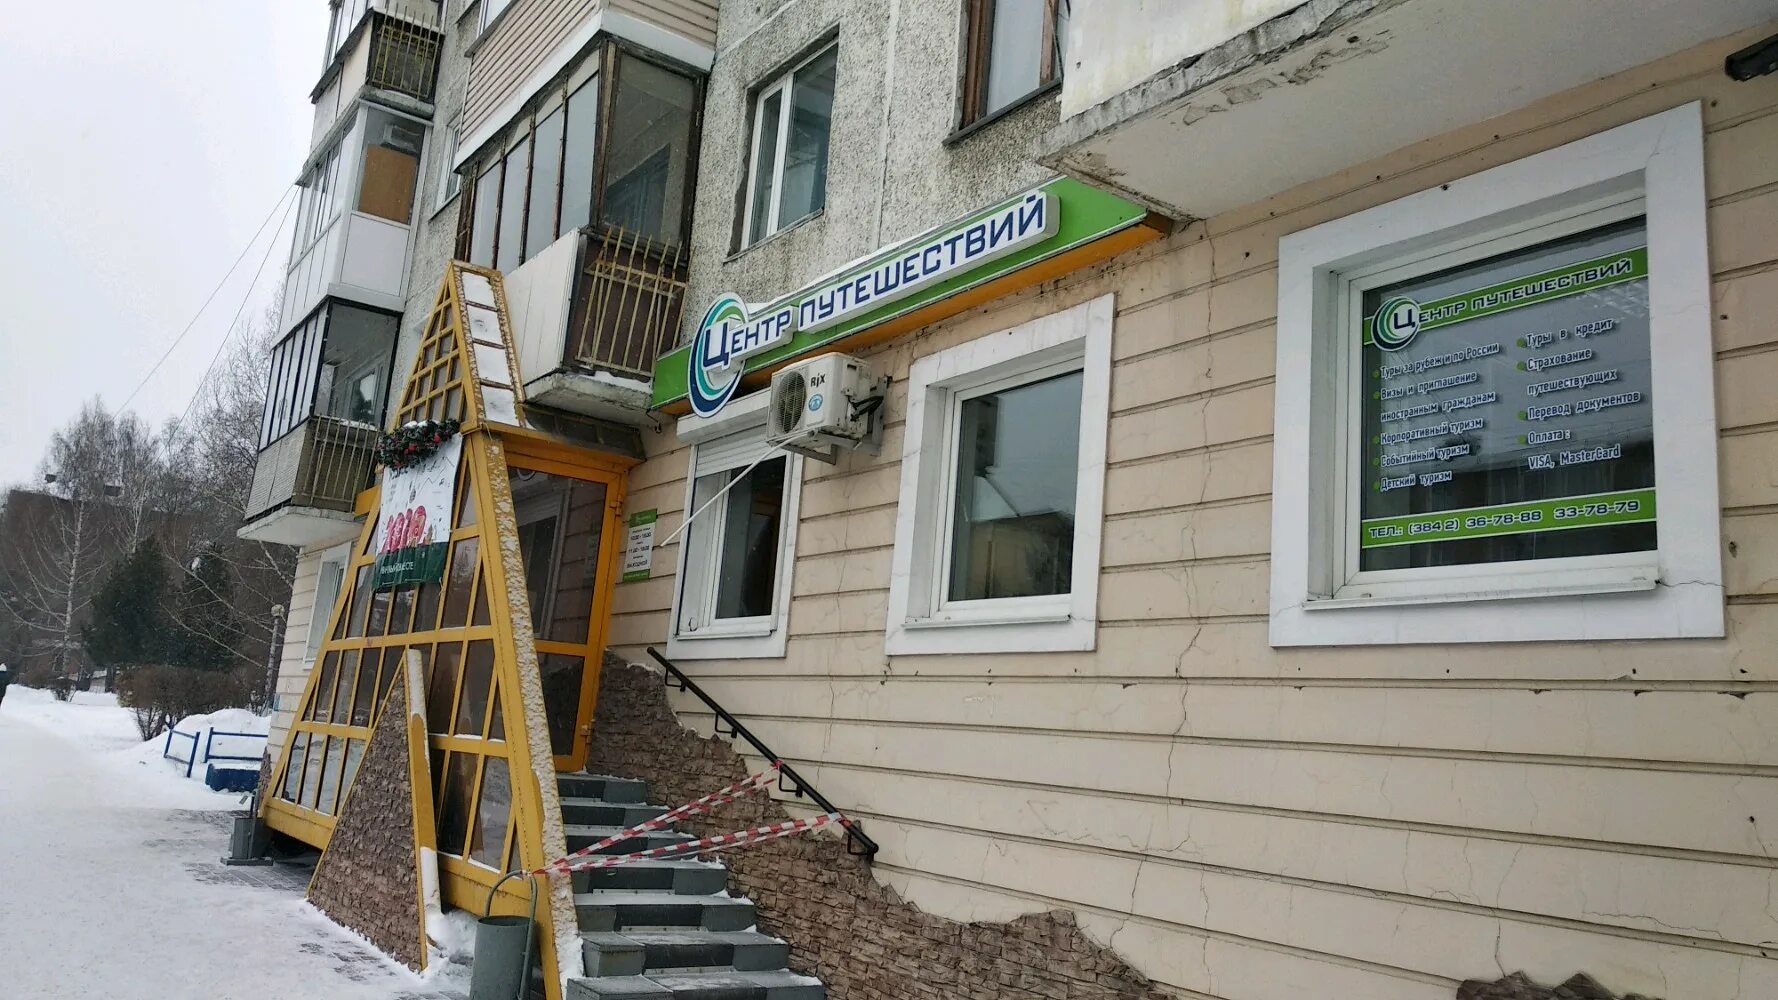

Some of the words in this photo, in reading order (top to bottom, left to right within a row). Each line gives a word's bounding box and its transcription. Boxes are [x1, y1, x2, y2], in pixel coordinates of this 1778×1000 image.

[703, 308, 792, 369] ЦЕНТР
[799, 194, 1044, 328] ПУТЕШЕСТВИЙ
[1392, 301, 1466, 331] ЦЕНТР
[1471, 258, 1632, 311] ПУТЕШЕСТВИЙ
[1527, 332, 1552, 348] Туры
[1560, 328, 1567, 339] в
[1575, 318, 1613, 337] кредит
[1381, 366, 1401, 379] Туры
[1403, 364, 1414, 373] за
[1415, 356, 1442, 372] рубеж
[1444, 356, 1451, 364] и
[1453, 352, 1465, 362] по
[1466, 344, 1499, 358] России
[1527, 348, 1591, 371] Страхование
[1381, 388, 1403, 399] Визы
[1407, 385, 1414, 394] и
[1418, 372, 1477, 394] приглашение
[1528, 369, 1618, 396] путешествующих
[1381, 404, 1438, 422] иностранным
[1442, 392, 1496, 412] гражданам
[1528, 403, 1572, 420] Перевод
[1576, 391, 1640, 413] документов
[1381, 423, 1449, 444] Корпоративный
[1450, 418, 1483, 434] туризм
[1381, 448, 1435, 466] Событийный
[1436, 445, 1469, 458] туризм
[1560, 444, 1621, 465] MasterCard
[1381, 474, 1415, 491] Детский
[1420, 471, 1452, 486] туризм
[1466, 509, 1543, 528] 36-78-88
[1554, 500, 1640, 519] 33-78-79
